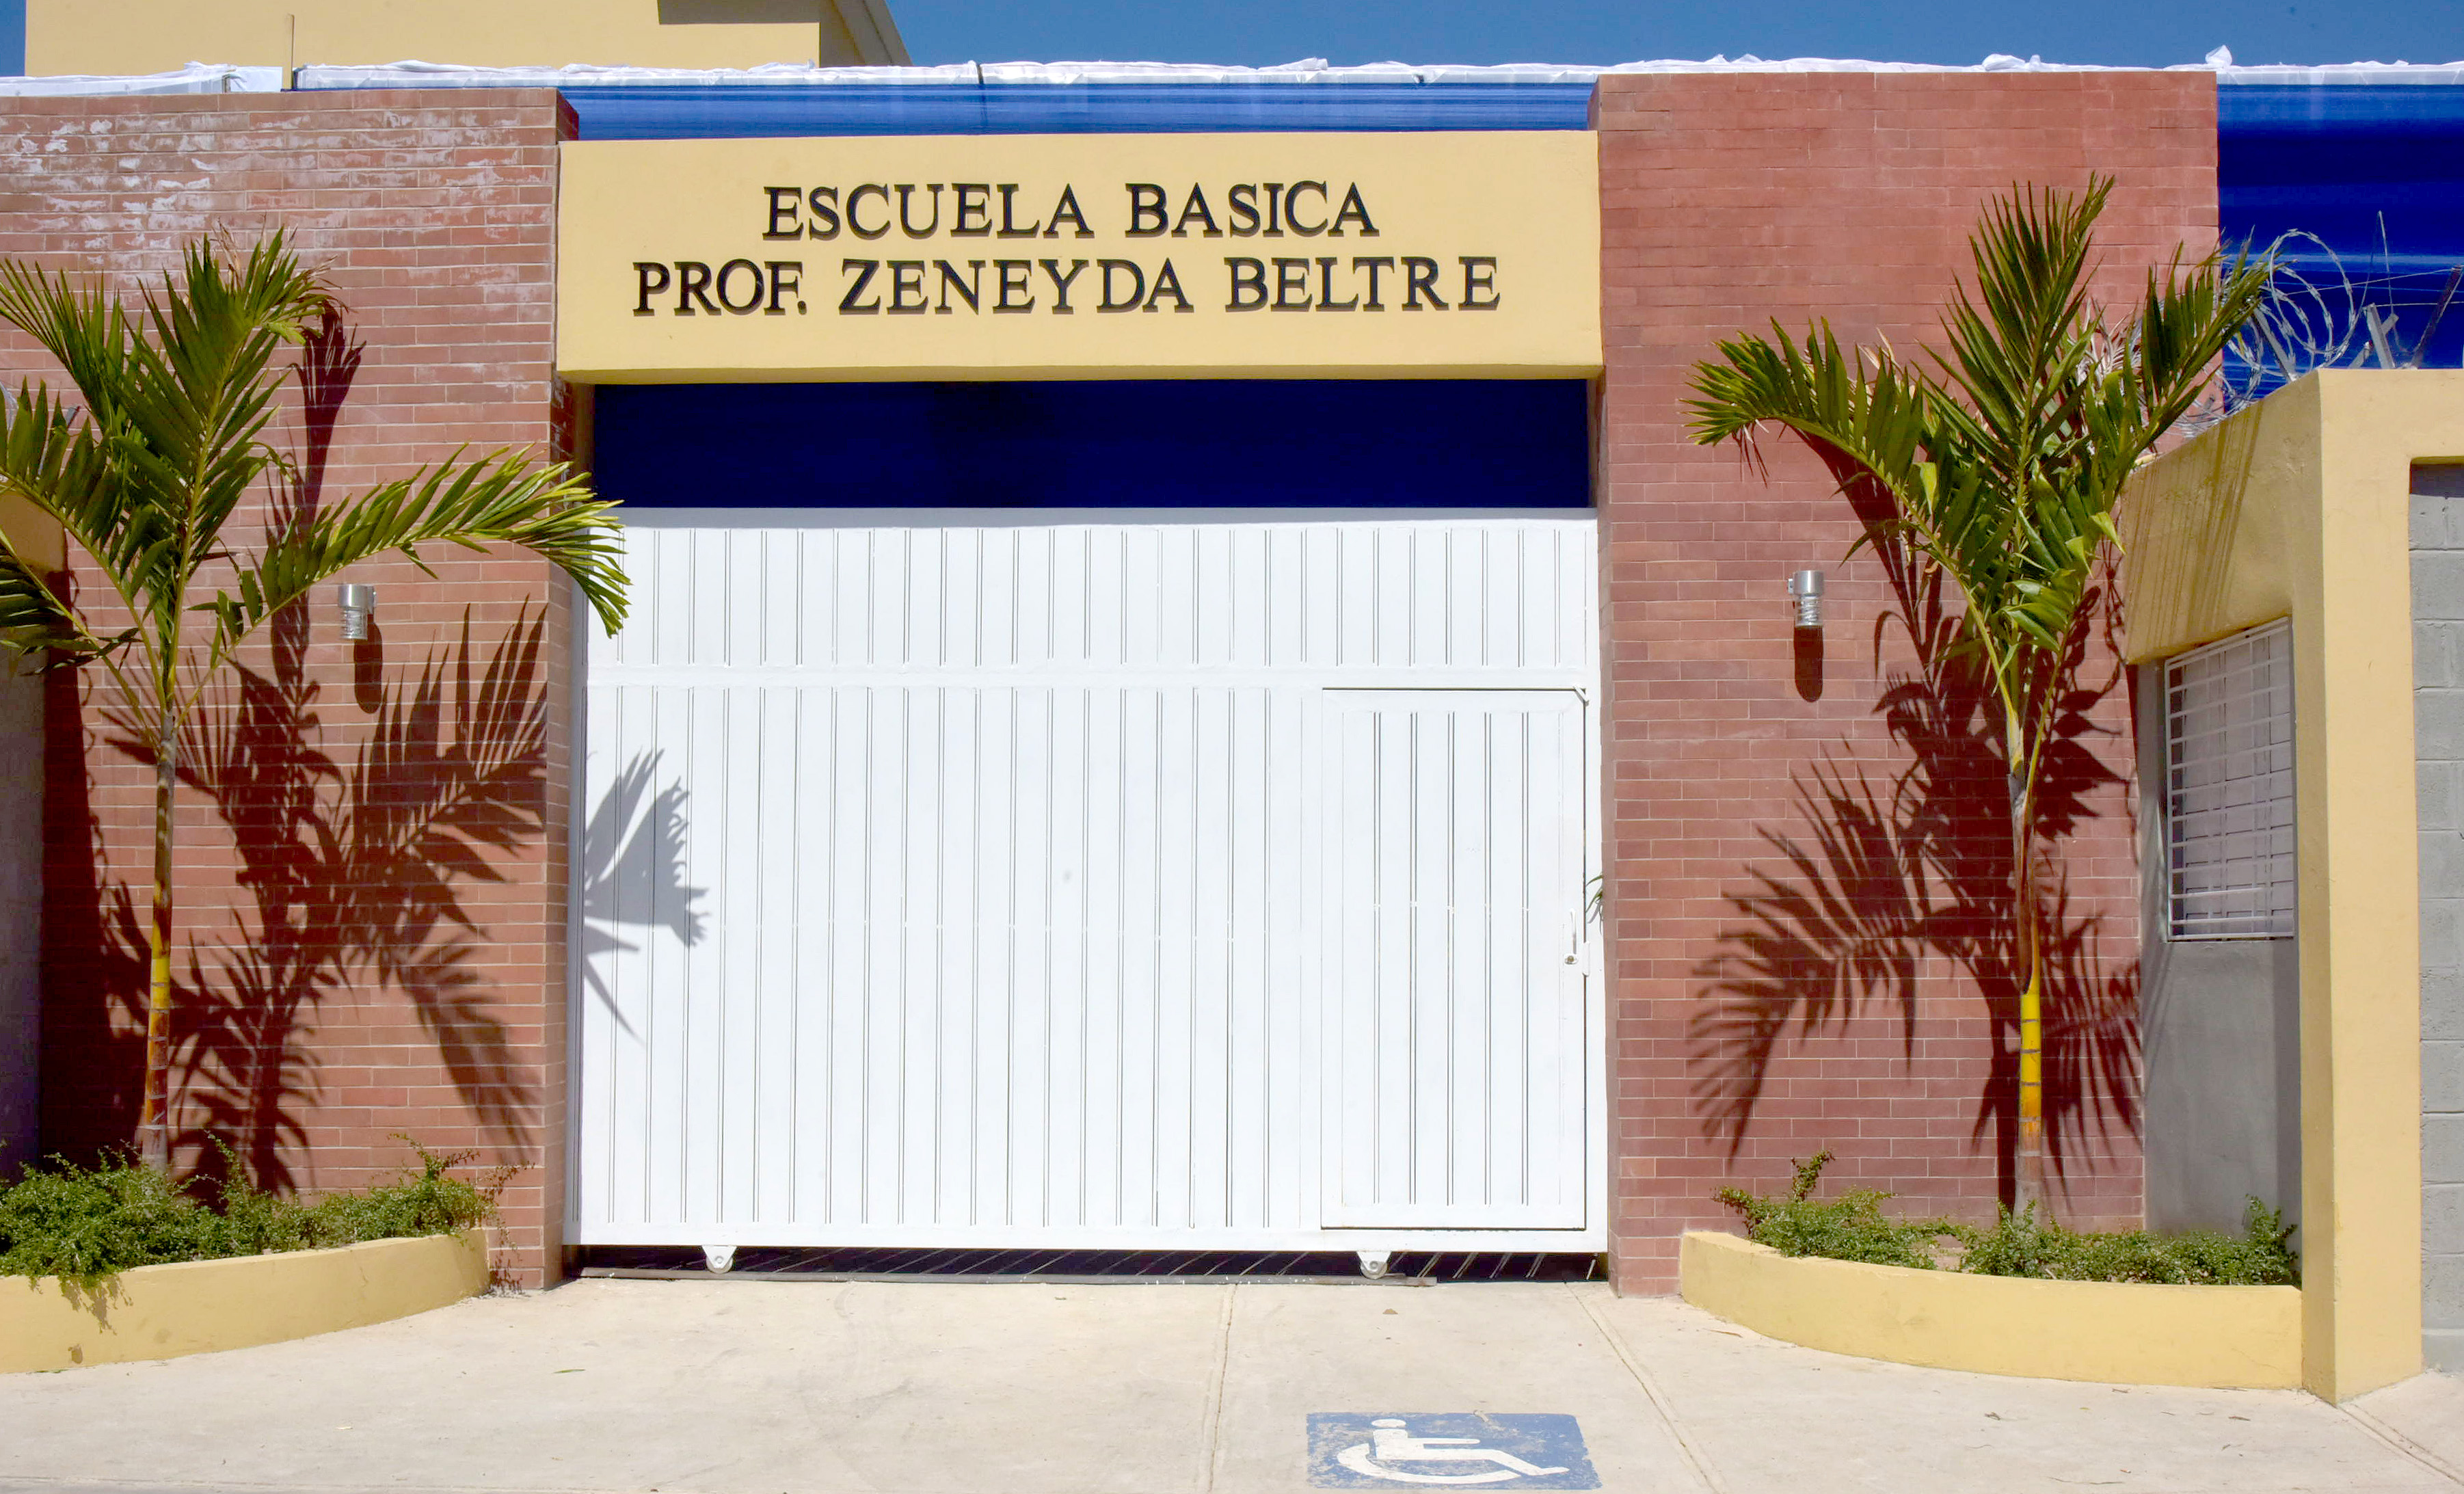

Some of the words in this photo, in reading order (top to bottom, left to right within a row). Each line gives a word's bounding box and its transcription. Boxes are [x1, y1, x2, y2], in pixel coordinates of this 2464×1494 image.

[764, 183, 1095, 239] ESCUELA
[1125, 181, 1379, 238] BASICA
[633, 258, 807, 316] PROF.
[839, 258, 1194, 315] ZENEYDA
[1224, 256, 1500, 312] BELTRE
